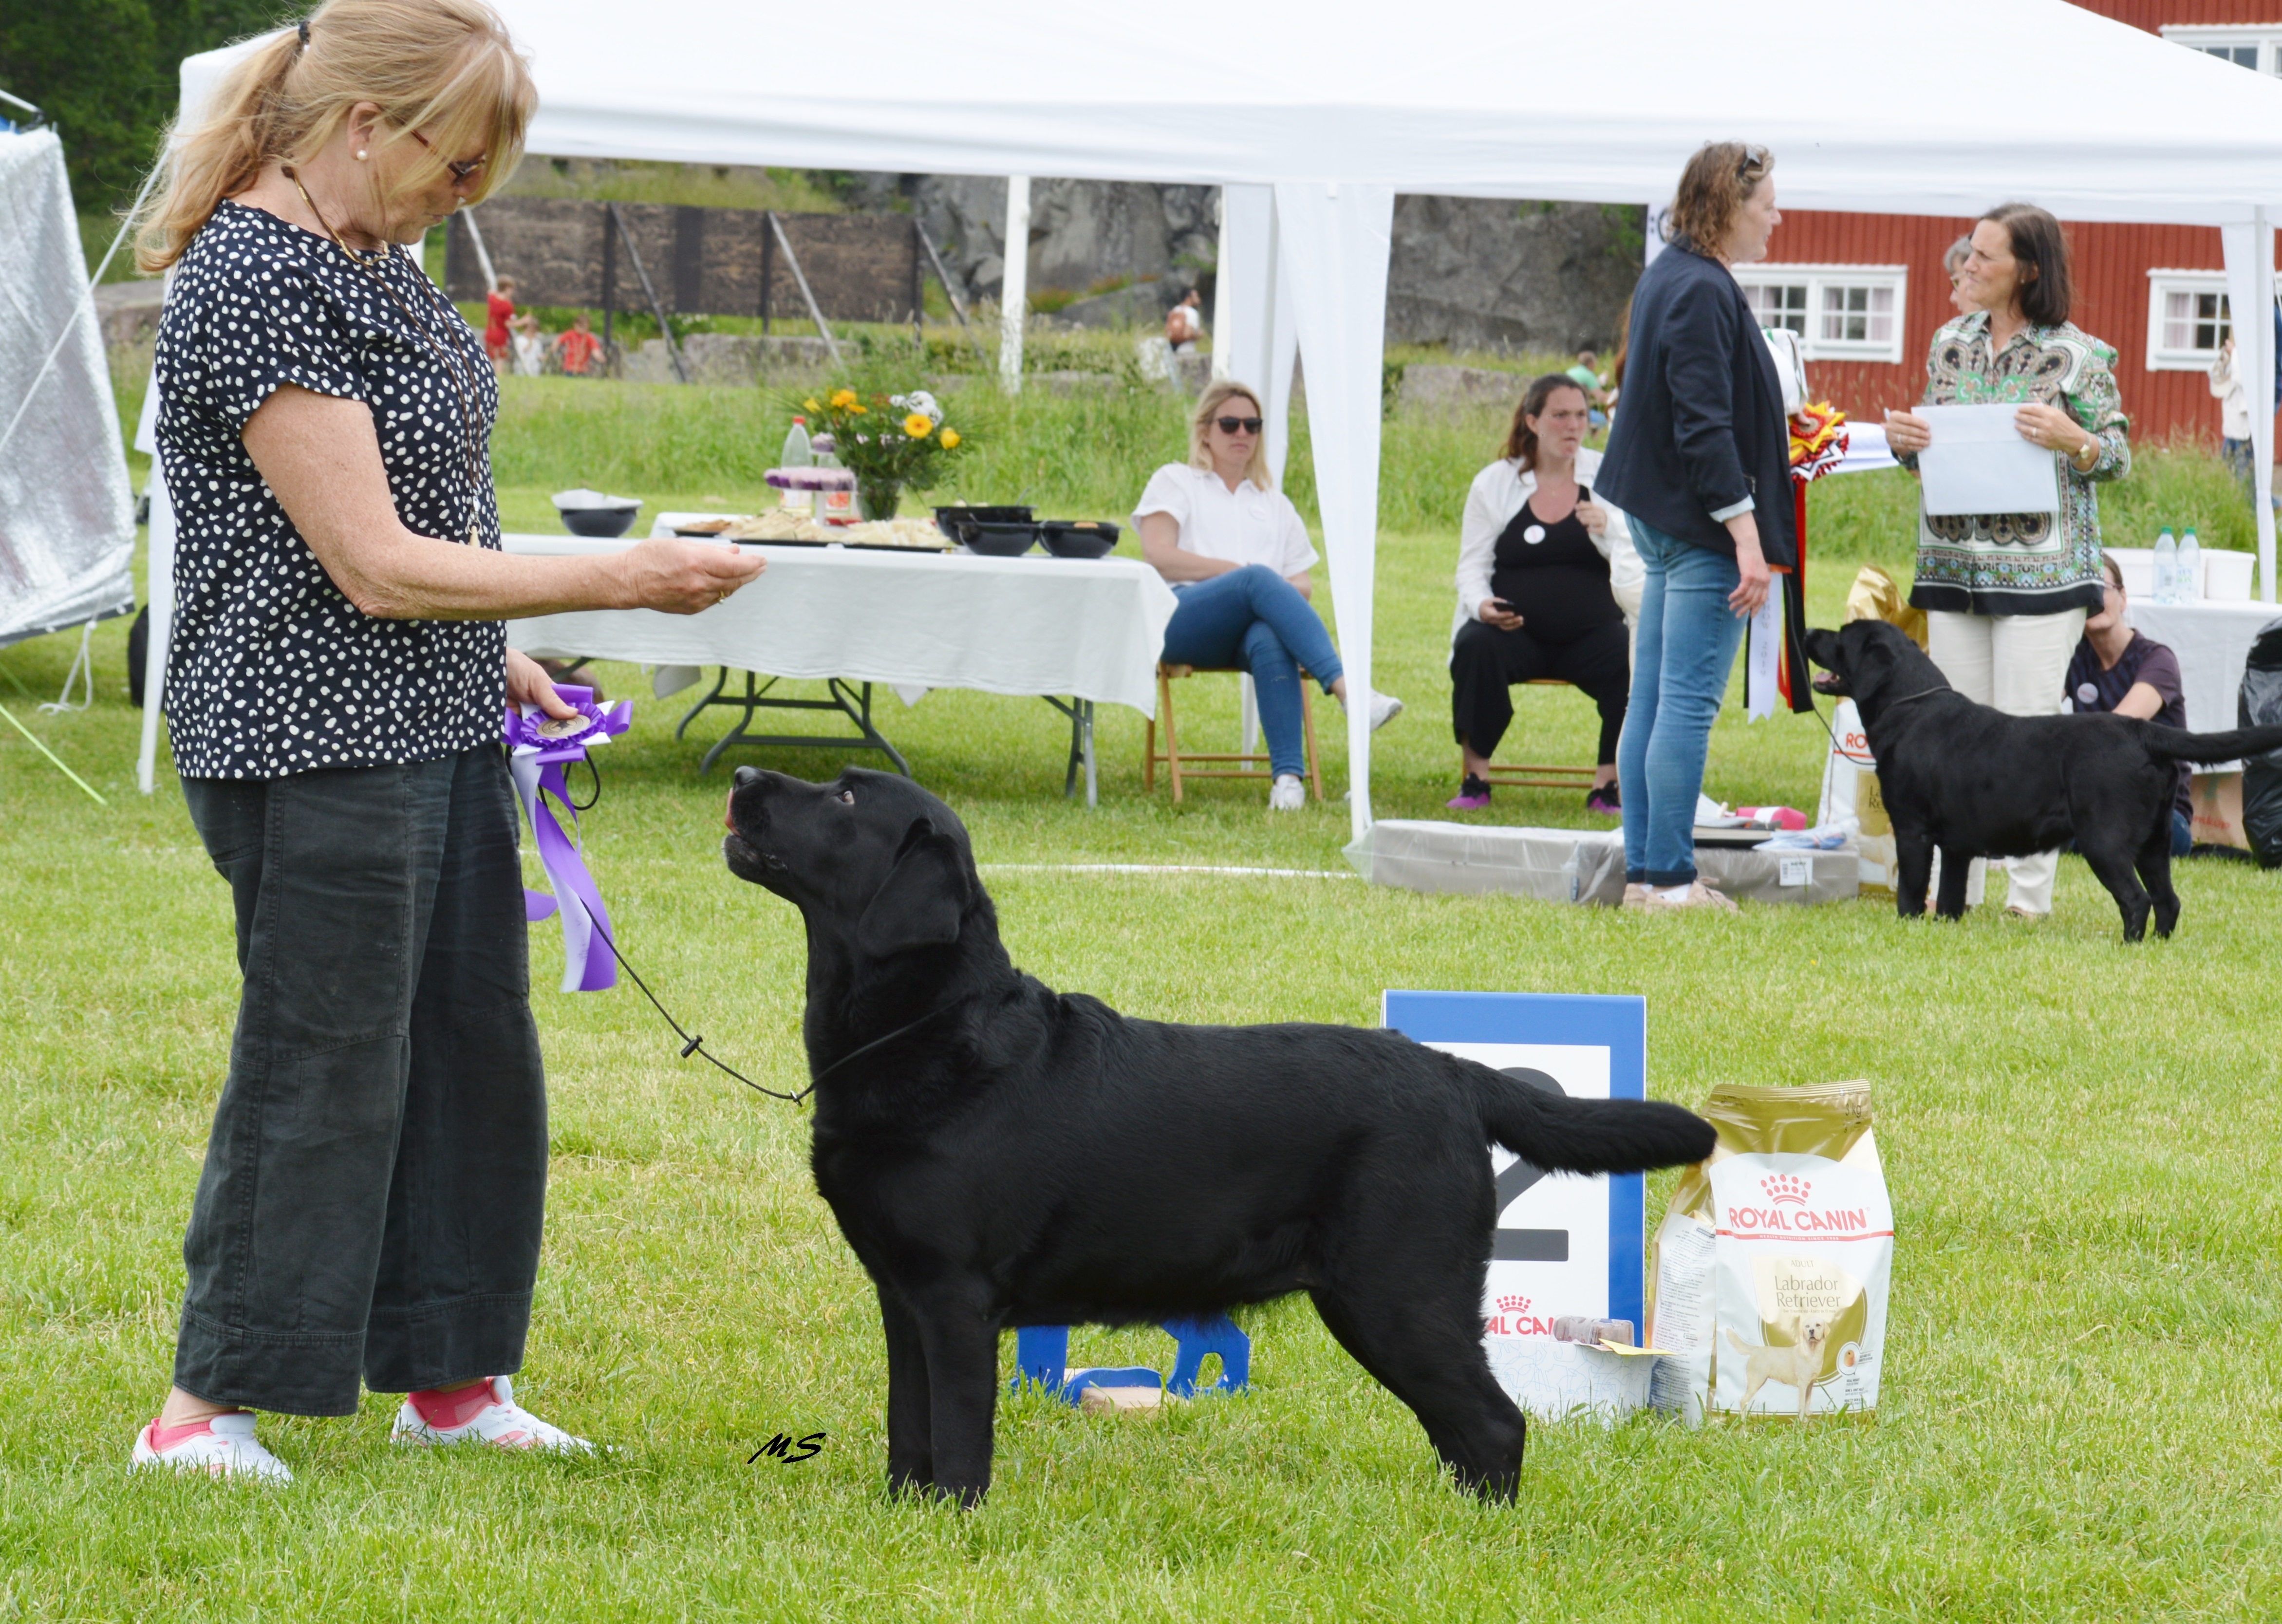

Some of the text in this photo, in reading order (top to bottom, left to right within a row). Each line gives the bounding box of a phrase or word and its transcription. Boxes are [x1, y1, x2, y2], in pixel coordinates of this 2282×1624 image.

[1845, 1103, 1861, 1118] 3 kg
[1728, 1207, 1867, 1231] ROYAL CANIN
[1791, 1259, 1814, 1268] ADULT
[1775, 1274, 1838, 1291] Labrador
[1776, 1292, 1841, 1307] Retriever
